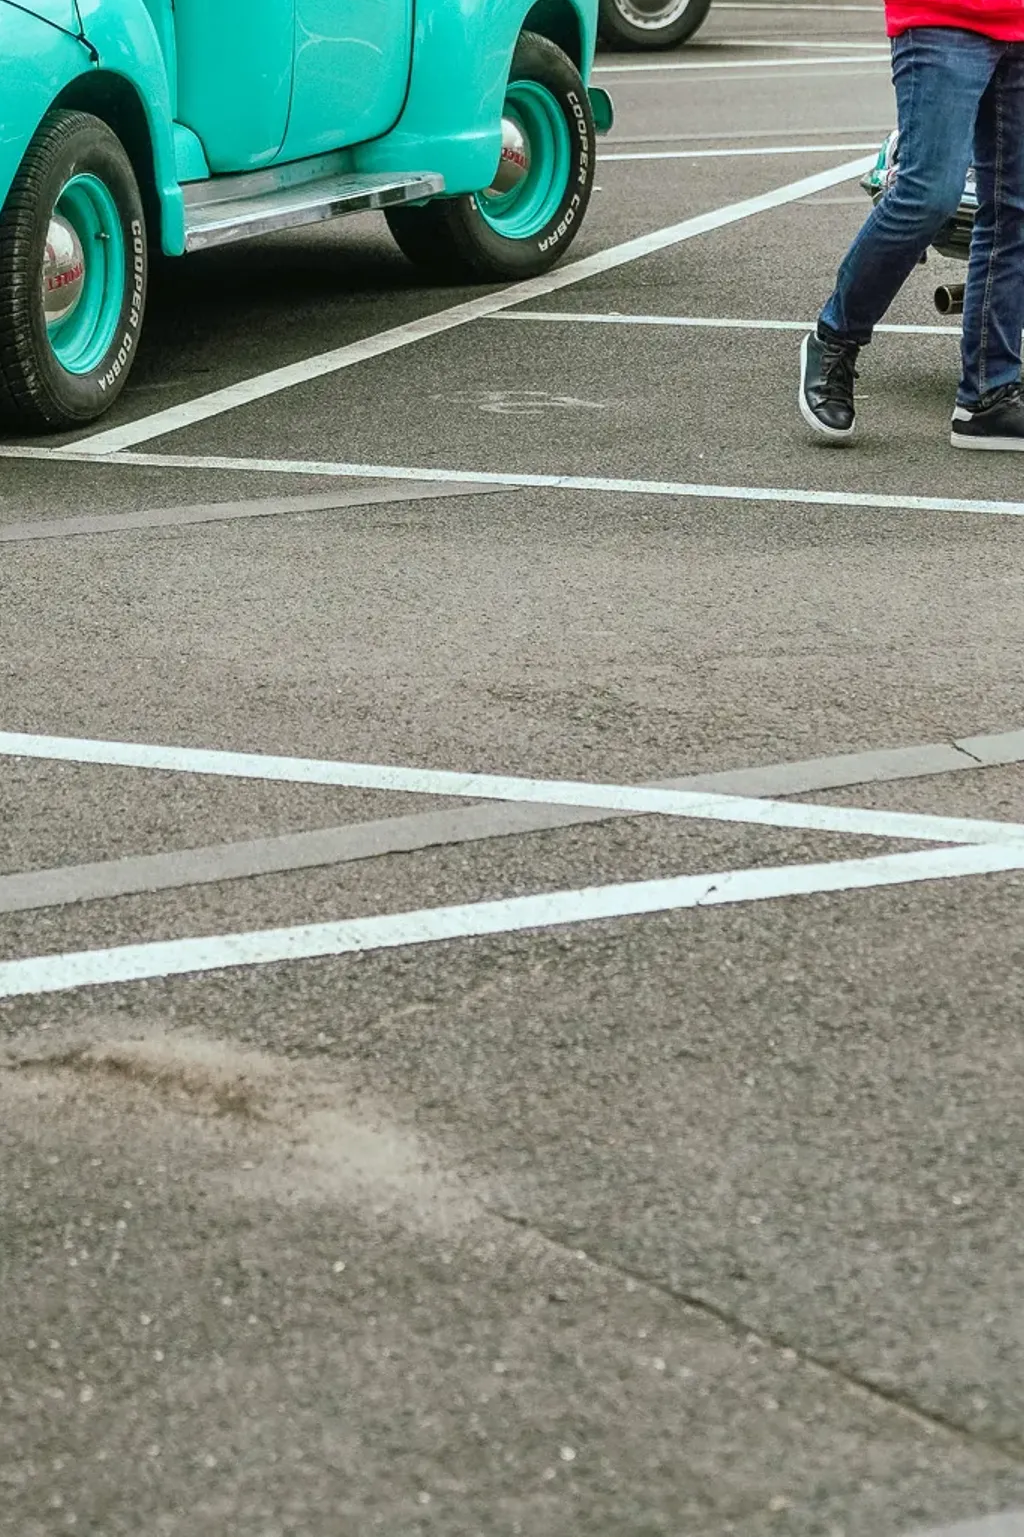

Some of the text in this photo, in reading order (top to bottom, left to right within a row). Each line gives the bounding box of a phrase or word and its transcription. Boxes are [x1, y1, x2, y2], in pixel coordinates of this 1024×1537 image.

[566, 91, 589, 185] COOPER
[538, 193, 581, 252] COBRA
[131, 219, 146, 328] COOPER
[98, 332, 133, 392] COBRA
